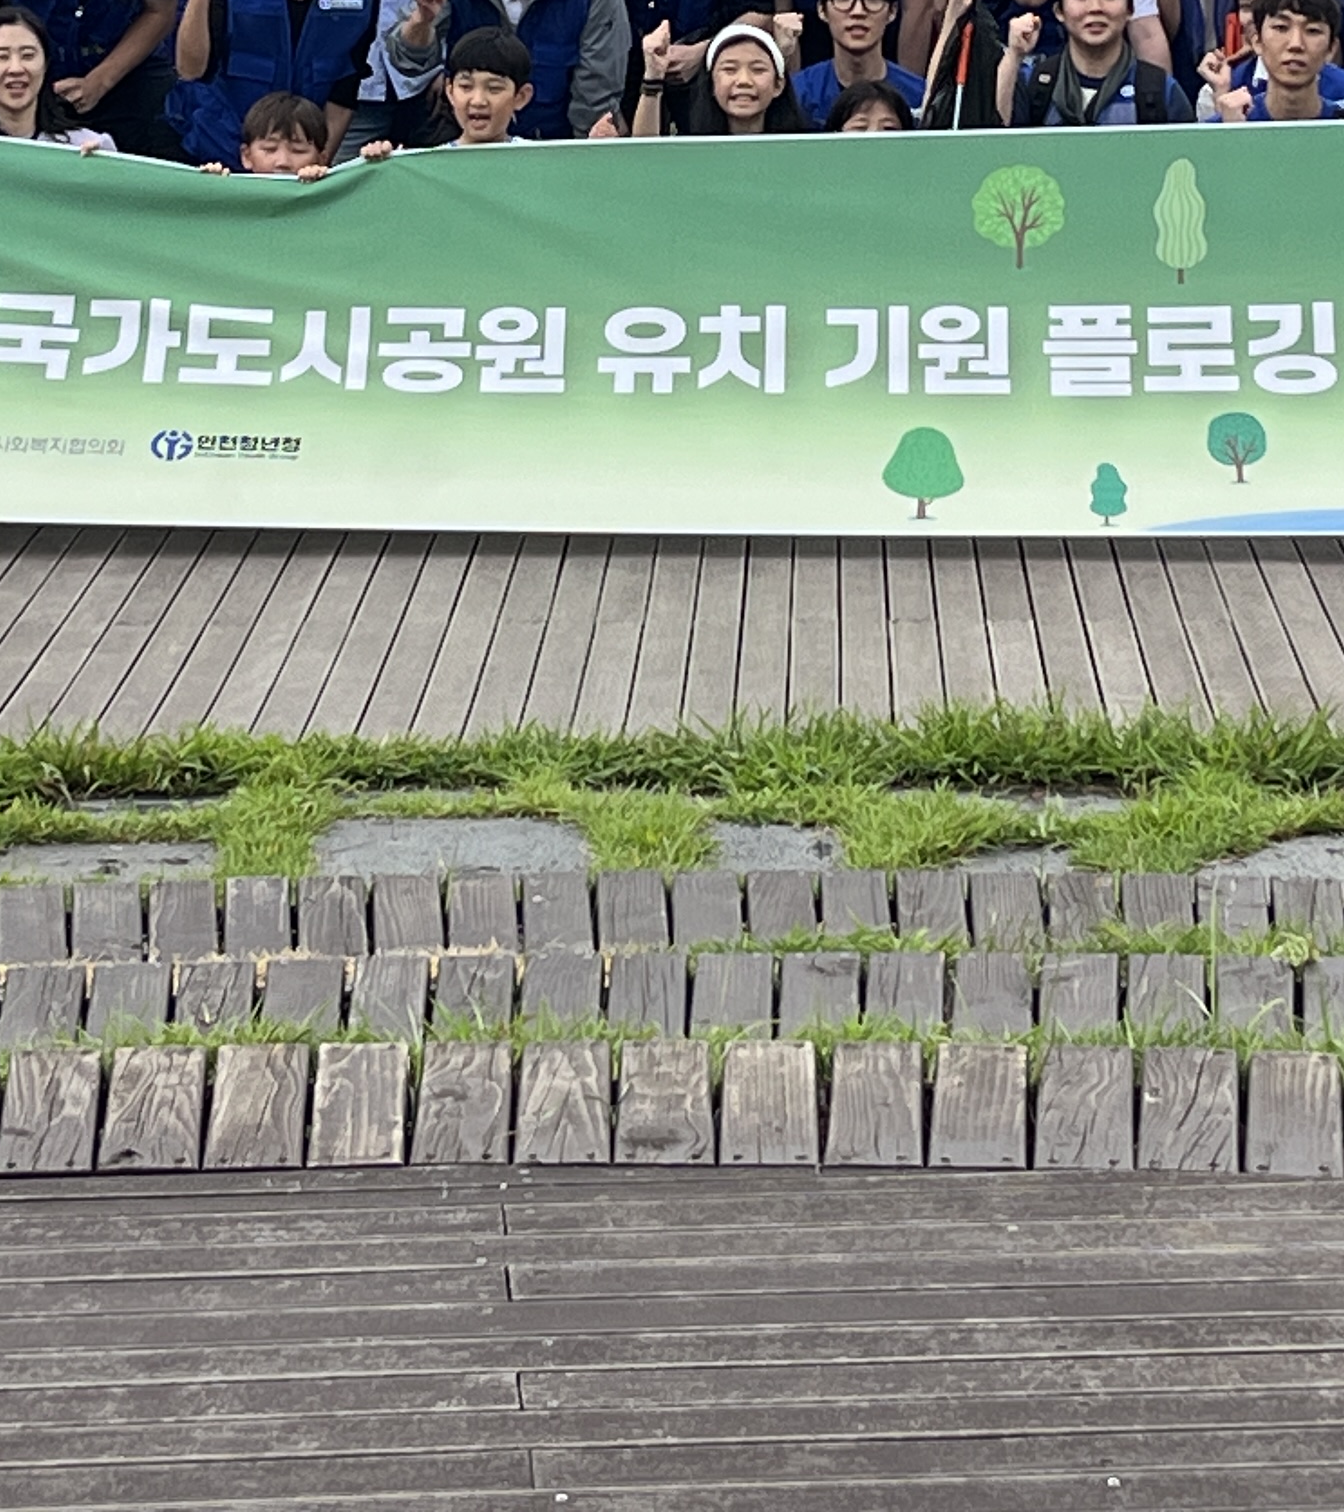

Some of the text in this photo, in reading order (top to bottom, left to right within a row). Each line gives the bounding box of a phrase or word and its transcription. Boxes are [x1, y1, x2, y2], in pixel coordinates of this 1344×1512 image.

[597, 303, 787, 395] 유치
[825, 304, 1012, 395] 기원
[1043, 300, 1338, 395] 플로깅
